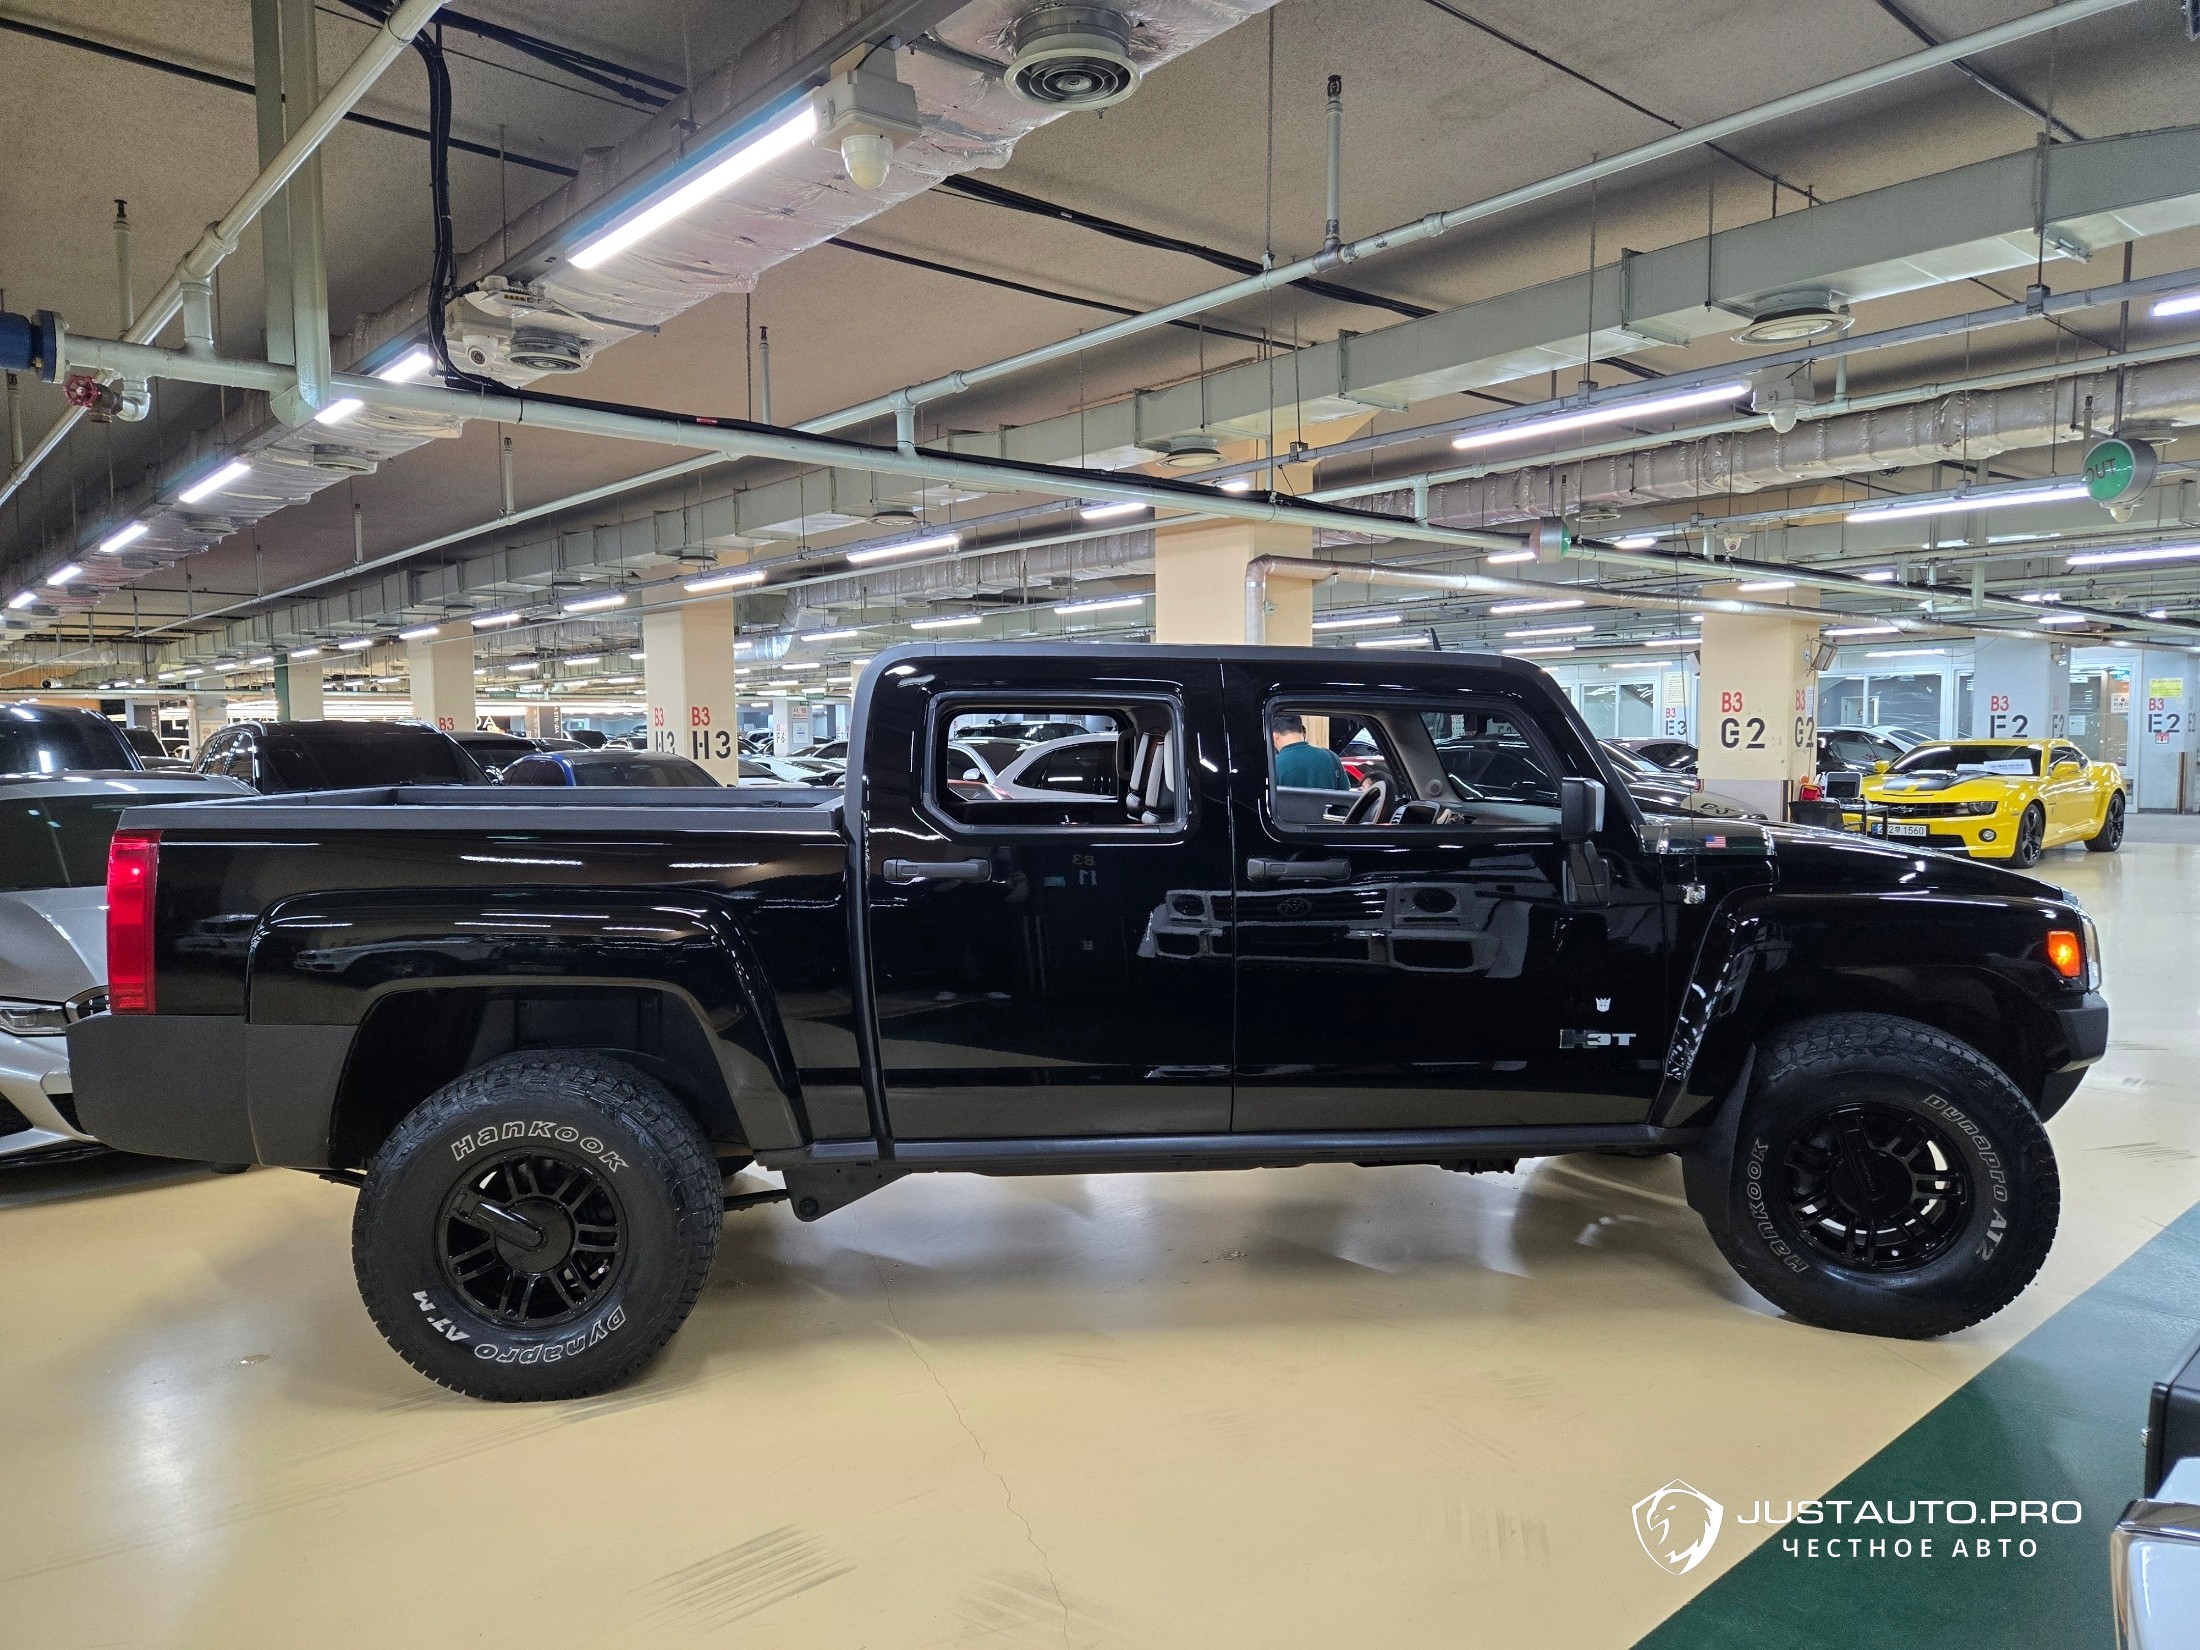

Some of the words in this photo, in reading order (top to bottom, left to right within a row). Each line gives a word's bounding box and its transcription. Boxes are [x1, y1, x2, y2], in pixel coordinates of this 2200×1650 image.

[2084, 457, 2116, 483] OUT
[1721, 691, 1743, 713] B3
[1795, 689, 1806, 711] B3
[1990, 695, 2010, 712] B3
[2148, 697, 2165, 711] B3
[654, 706, 665, 727] B3
[691, 706, 711, 727] B3
[1665, 707, 1677, 718] B3
[2147, 713, 2180, 733] E2
[438, 717, 455, 731] B3
[1665, 720, 1687, 736] E3
[1720, 717, 1766, 749] G2
[1794, 716, 1815, 748] G2
[692, 730, 731, 760] H3
[1903, 826, 1924, 835] 1560
[1974, 1208, 2008, 1262] AT2
